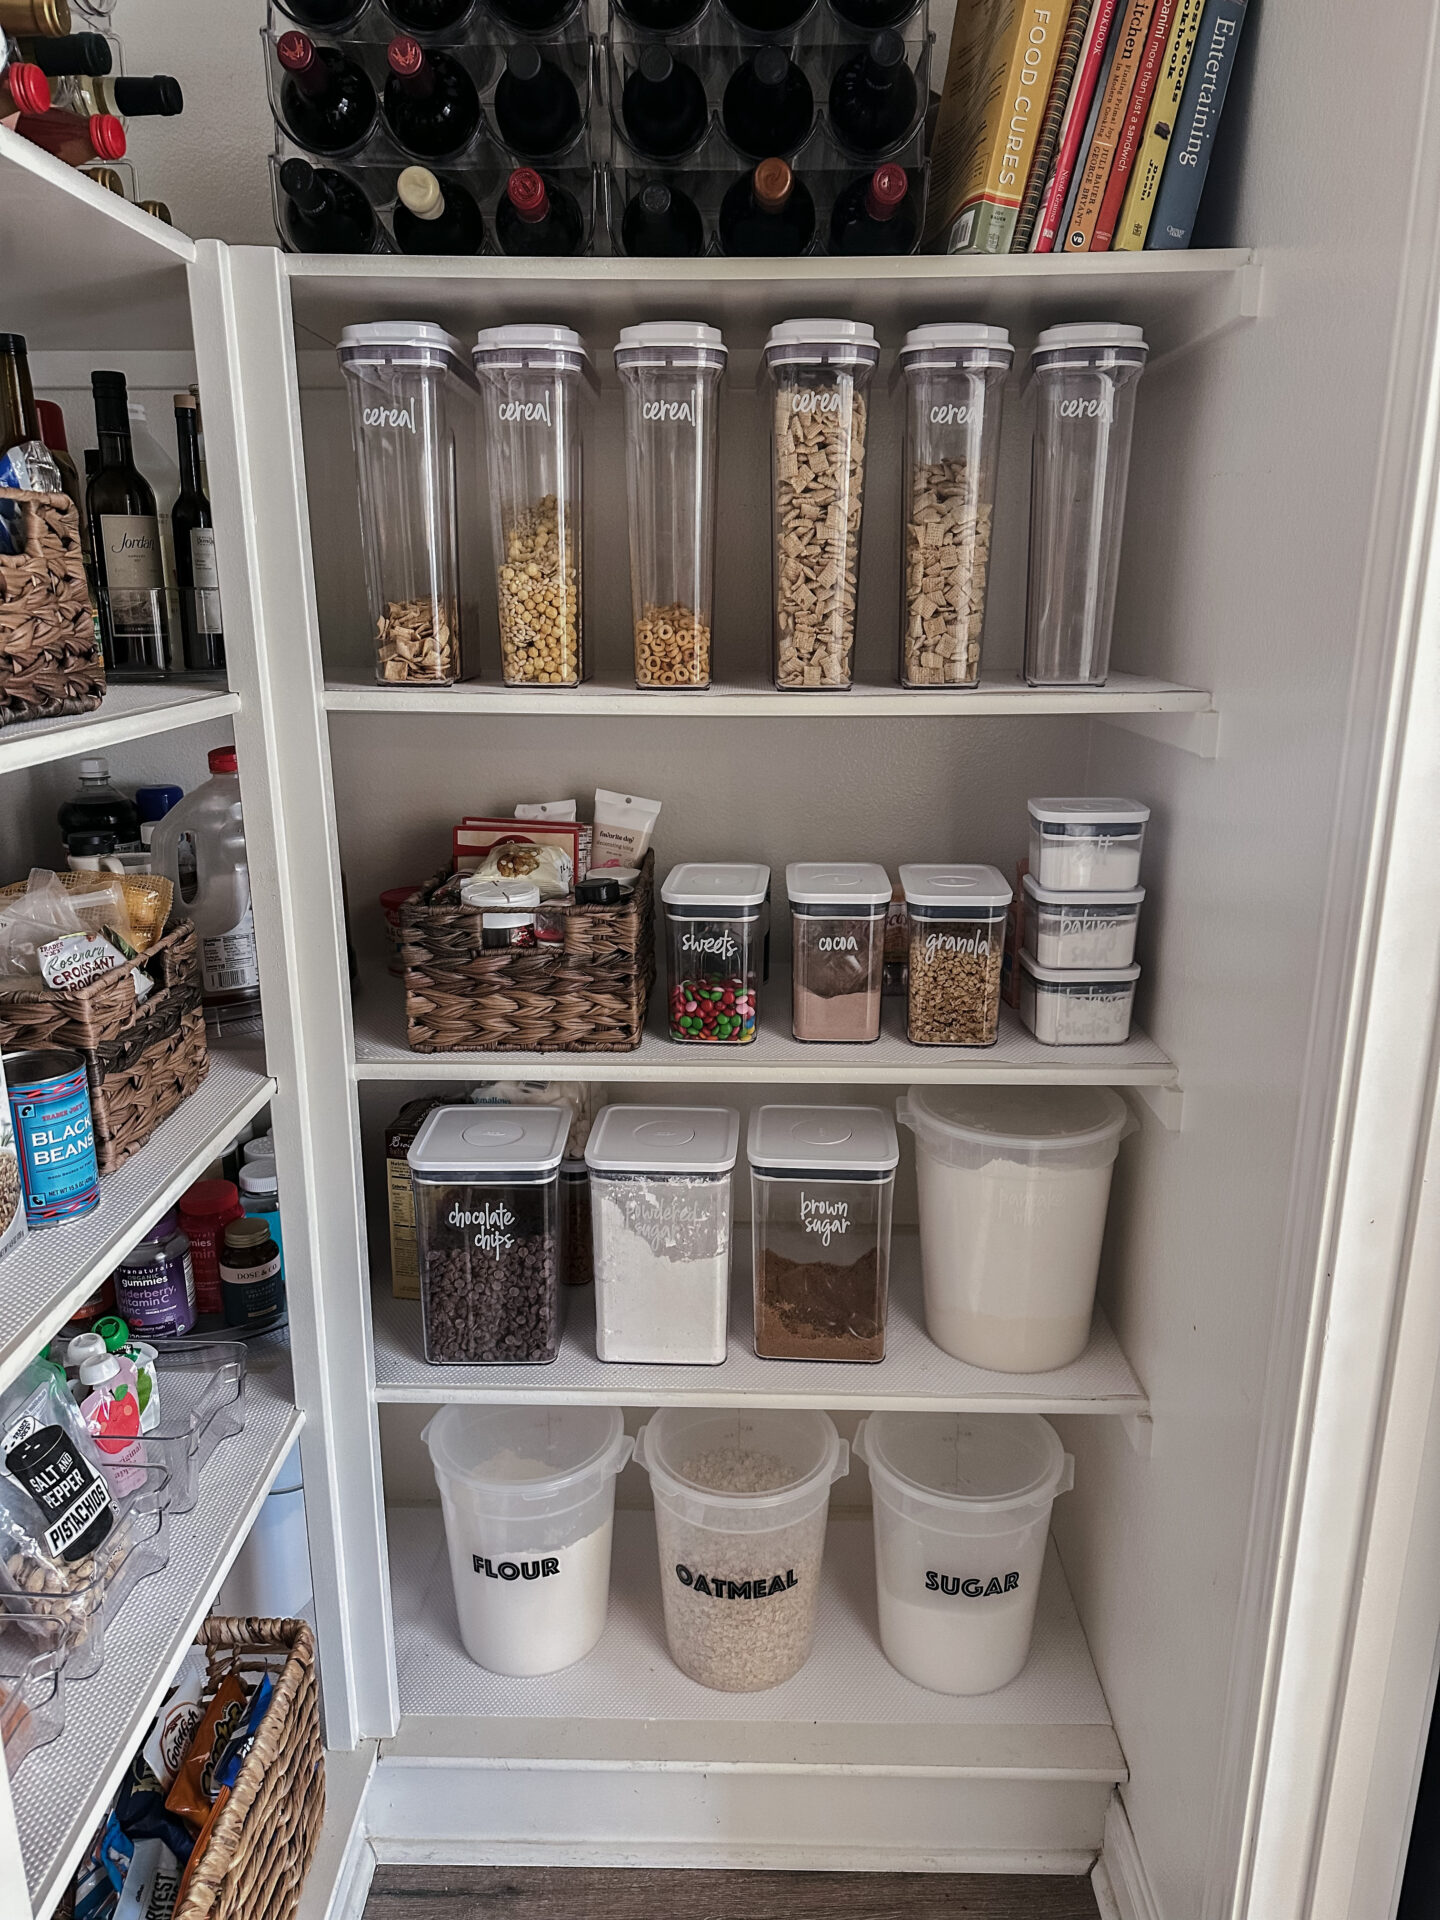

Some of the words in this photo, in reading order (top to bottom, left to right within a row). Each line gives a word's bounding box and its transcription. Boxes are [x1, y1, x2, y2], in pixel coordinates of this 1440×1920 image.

[1093, 0, 1115, 55] OOKBOOK
[1121, 0, 1149, 60] itchen
[1154, 0, 1173, 39] panini
[1020, 8, 1050, 86] FOOD
[1145, 41, 1159, 69] more
[1119, 64, 1132, 96] Finding
[1138, 70, 1153, 94] than
[1172, 38, 1195, 103] Foods
[1107, 74, 1120, 102] Modern
[1133, 94, 1146, 115] just
[1179, 15, 1236, 168] Entertaining
[1096, 106, 1112, 138] Cooking
[1111, 97, 1124, 127] Primal
[999, 96, 1032, 186] CURES
[1105, 122, 1116, 140] Joy
[1098, 147, 1110, 170] JULI
[1117, 123, 1137, 173] sandwich
[1085, 146, 1101, 184] GEORGE
[1139, 158, 1153, 201] Jacobi
[1146, 165, 1159, 198] Dana
[1089, 172, 1104, 206] BAUER
[1075, 187, 1091, 227] BRYANT
[1085, 209, 1093, 217] &
[363, 397, 416, 434] cereal
[499, 390, 552, 427] cereal
[643, 389, 696, 427] cereal
[792, 390, 844, 416] cerea
[600, 830, 623, 842] favorite
[682, 932, 738, 960] sweets
[818, 934, 858, 953] cocoa
[925, 928, 991, 964] granola
[47, 945, 106, 976] Rosemary
[52, 955, 116, 986] CROISSANT
[31, 1113, 92, 1147] BLACK
[33, 1133, 94, 1166] BEANS
[448, 1203, 515, 1227] chocolate
[800, 1192, 849, 1225] brown
[474, 1226, 514, 1261] chips
[804, 1213, 851, 1246] sugar
[121, 1275, 168, 1288] gummies
[237, 1271, 258, 1280] DOSE
[121, 1297, 160, 1307] vitamin
[161, 1294, 170, 1303] C
[13, 1419, 30, 1440] TRADER
[29, 1464, 60, 1493] SALT
[57, 1452, 73, 1473] AND
[42, 1468, 85, 1509] PEPPER
[49, 1483, 107, 1551] PISTACHIOS
[472, 1553, 560, 1581] FLOUR
[675, 1563, 799, 1600] OATMEAL
[924, 1570, 1020, 1598] SUGAR
[166, 1708, 199, 1769] Goldfish
